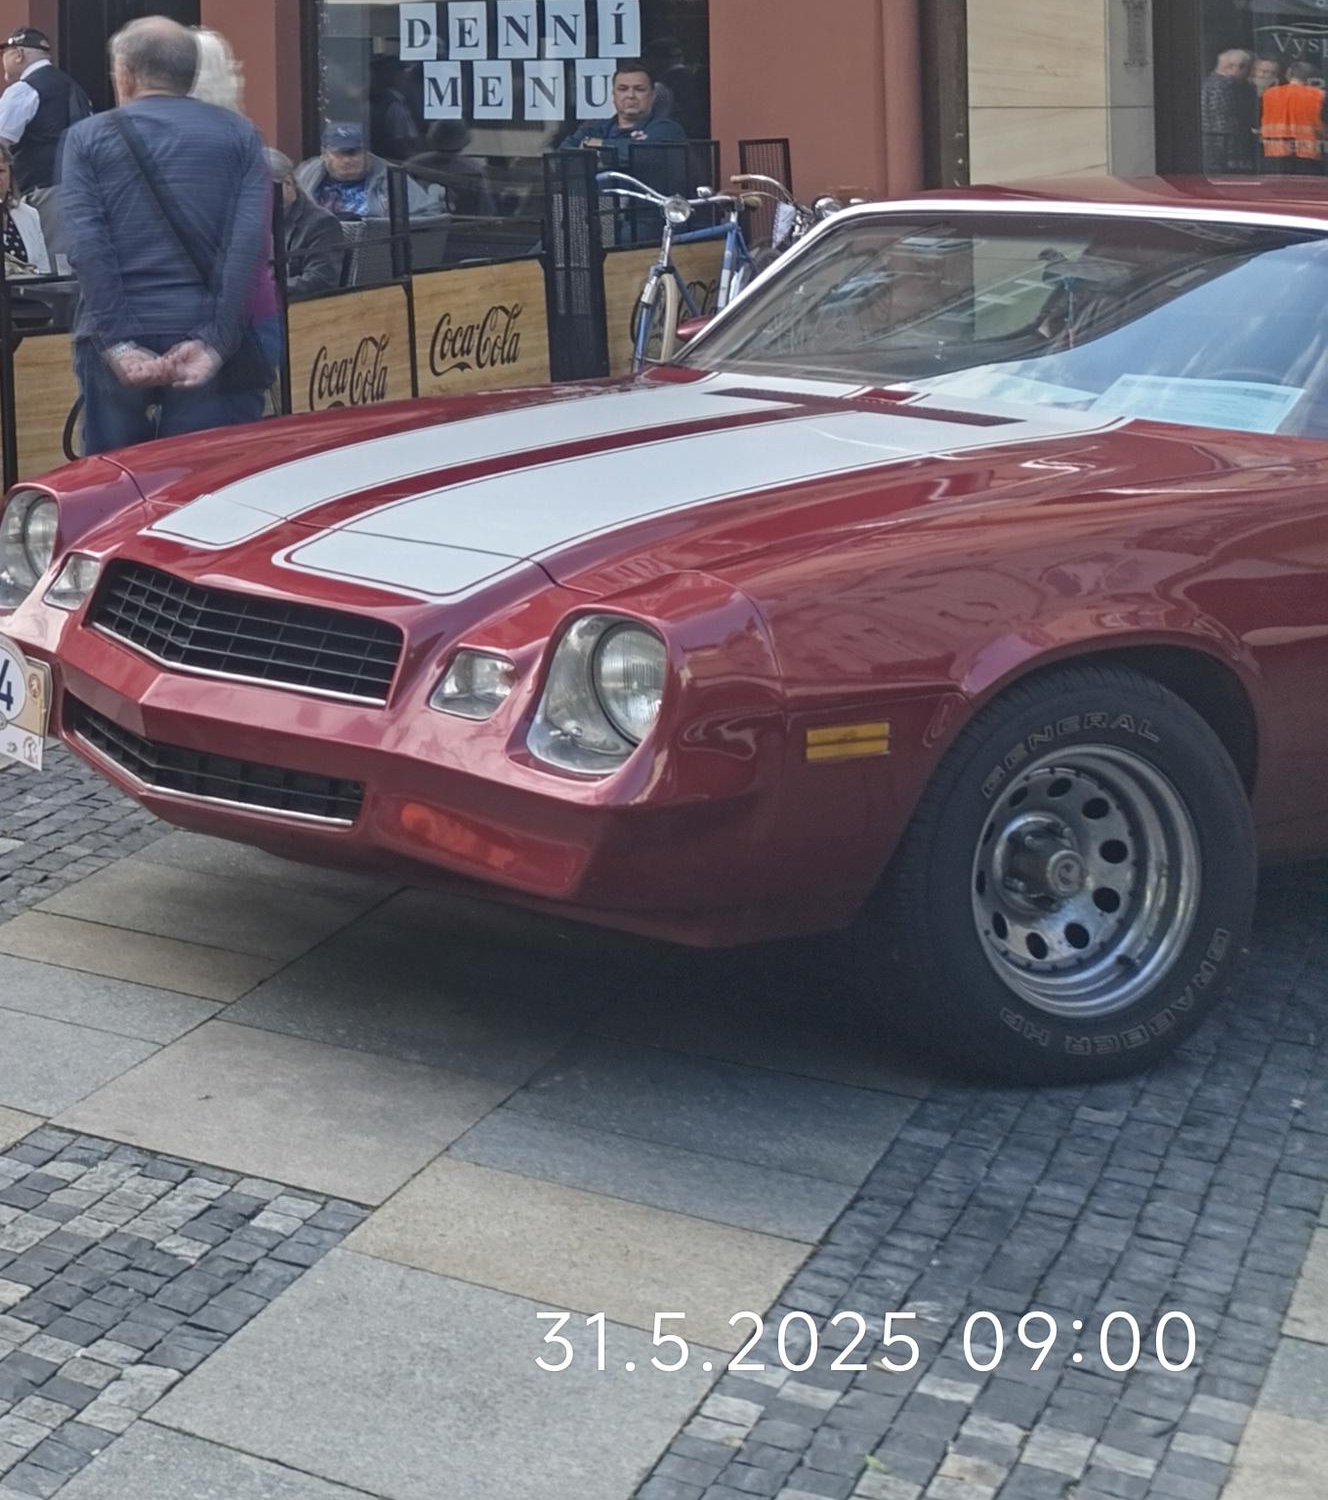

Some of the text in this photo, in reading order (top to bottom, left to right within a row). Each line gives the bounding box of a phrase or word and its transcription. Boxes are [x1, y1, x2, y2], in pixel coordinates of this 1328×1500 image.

[404, 2, 628, 49] DENNÍ
[425, 74, 612, 109] MENU
[429, 303, 525, 377] Coca-Cola
[308, 331, 391, 411] Coca-Cola
[980, 711, 1160, 800] GENERAL
[999, 1007, 1052, 1047] HP
